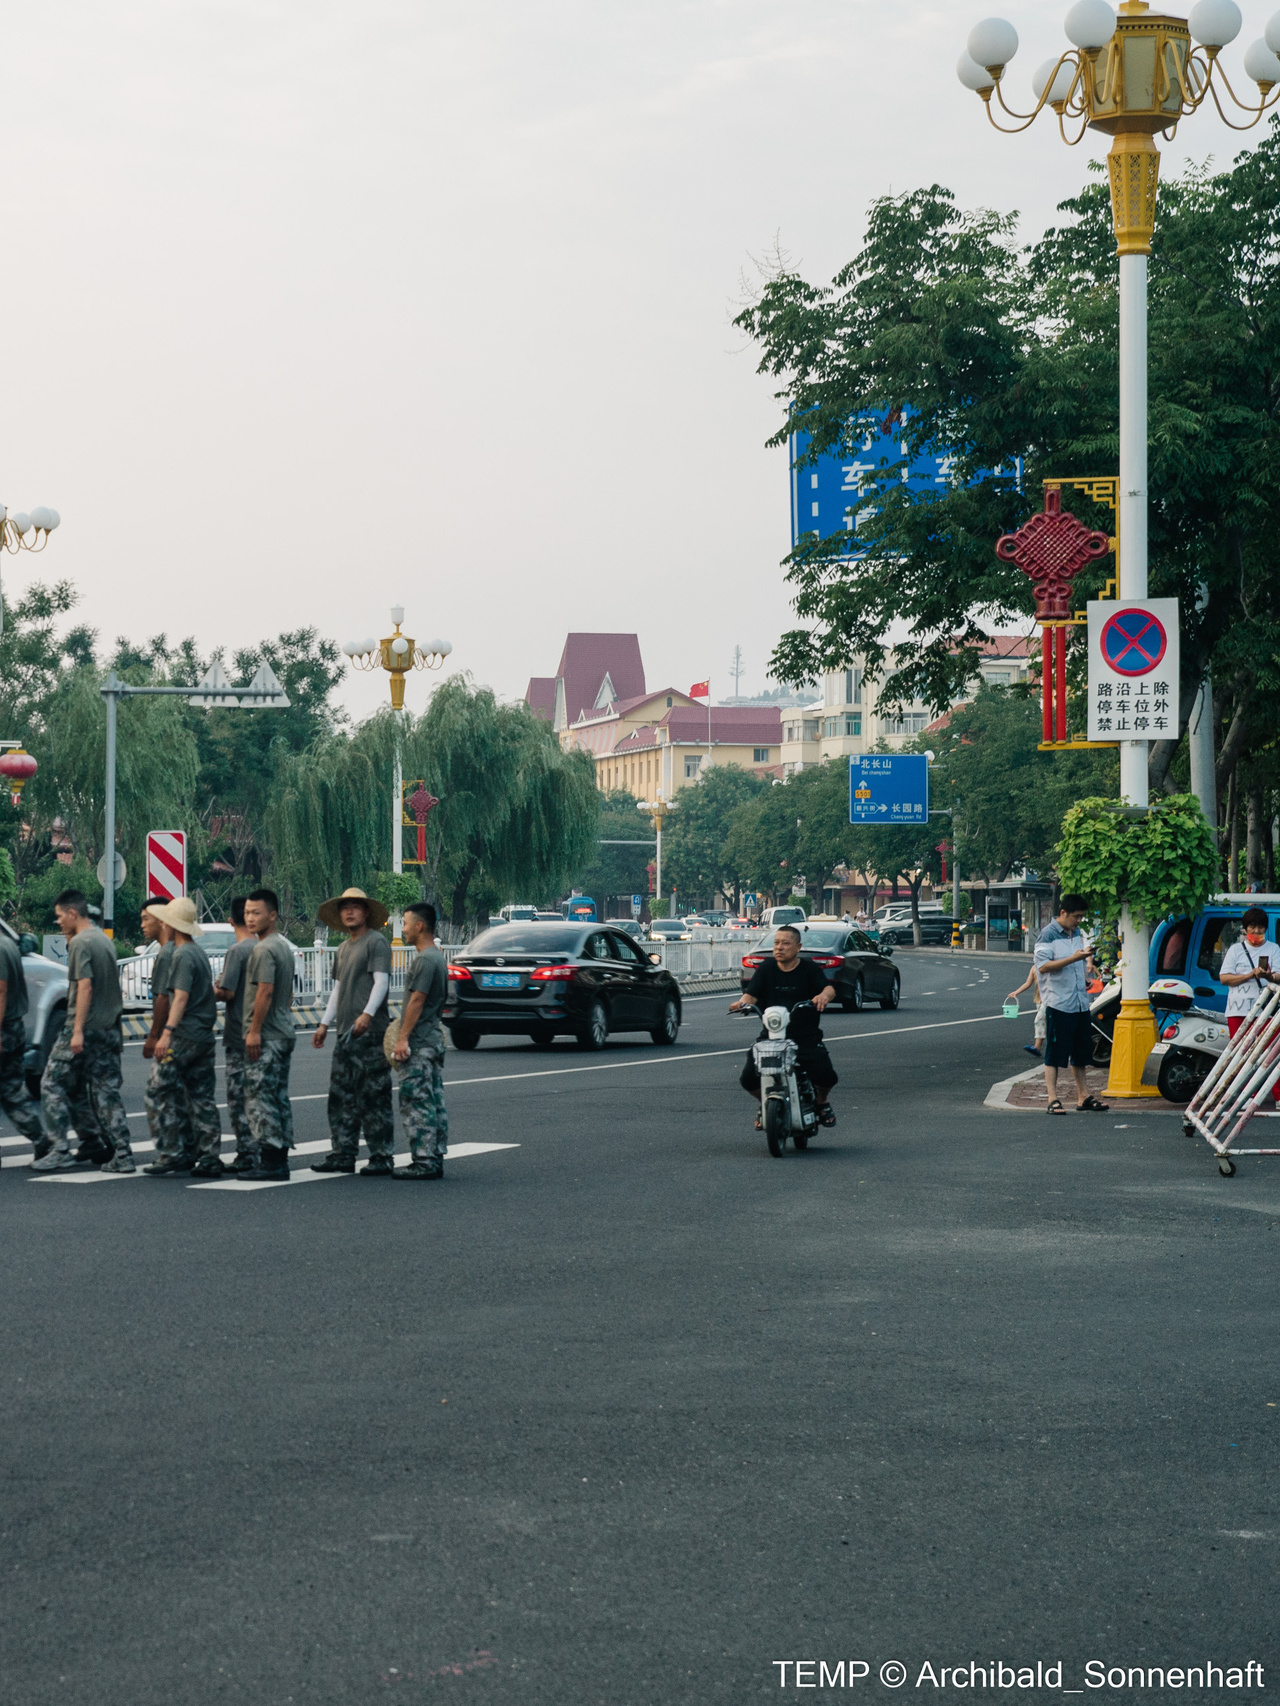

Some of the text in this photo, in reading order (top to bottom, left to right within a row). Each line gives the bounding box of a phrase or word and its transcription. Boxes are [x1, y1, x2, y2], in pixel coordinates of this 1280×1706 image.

[1097, 681, 1170, 697] 路沿上除
[1096, 698, 1170, 714] 停车位外
[1097, 716, 1169, 731] 禁止停车
[860, 759, 892, 768] 北长山
[891, 803, 923, 812] 长园路
